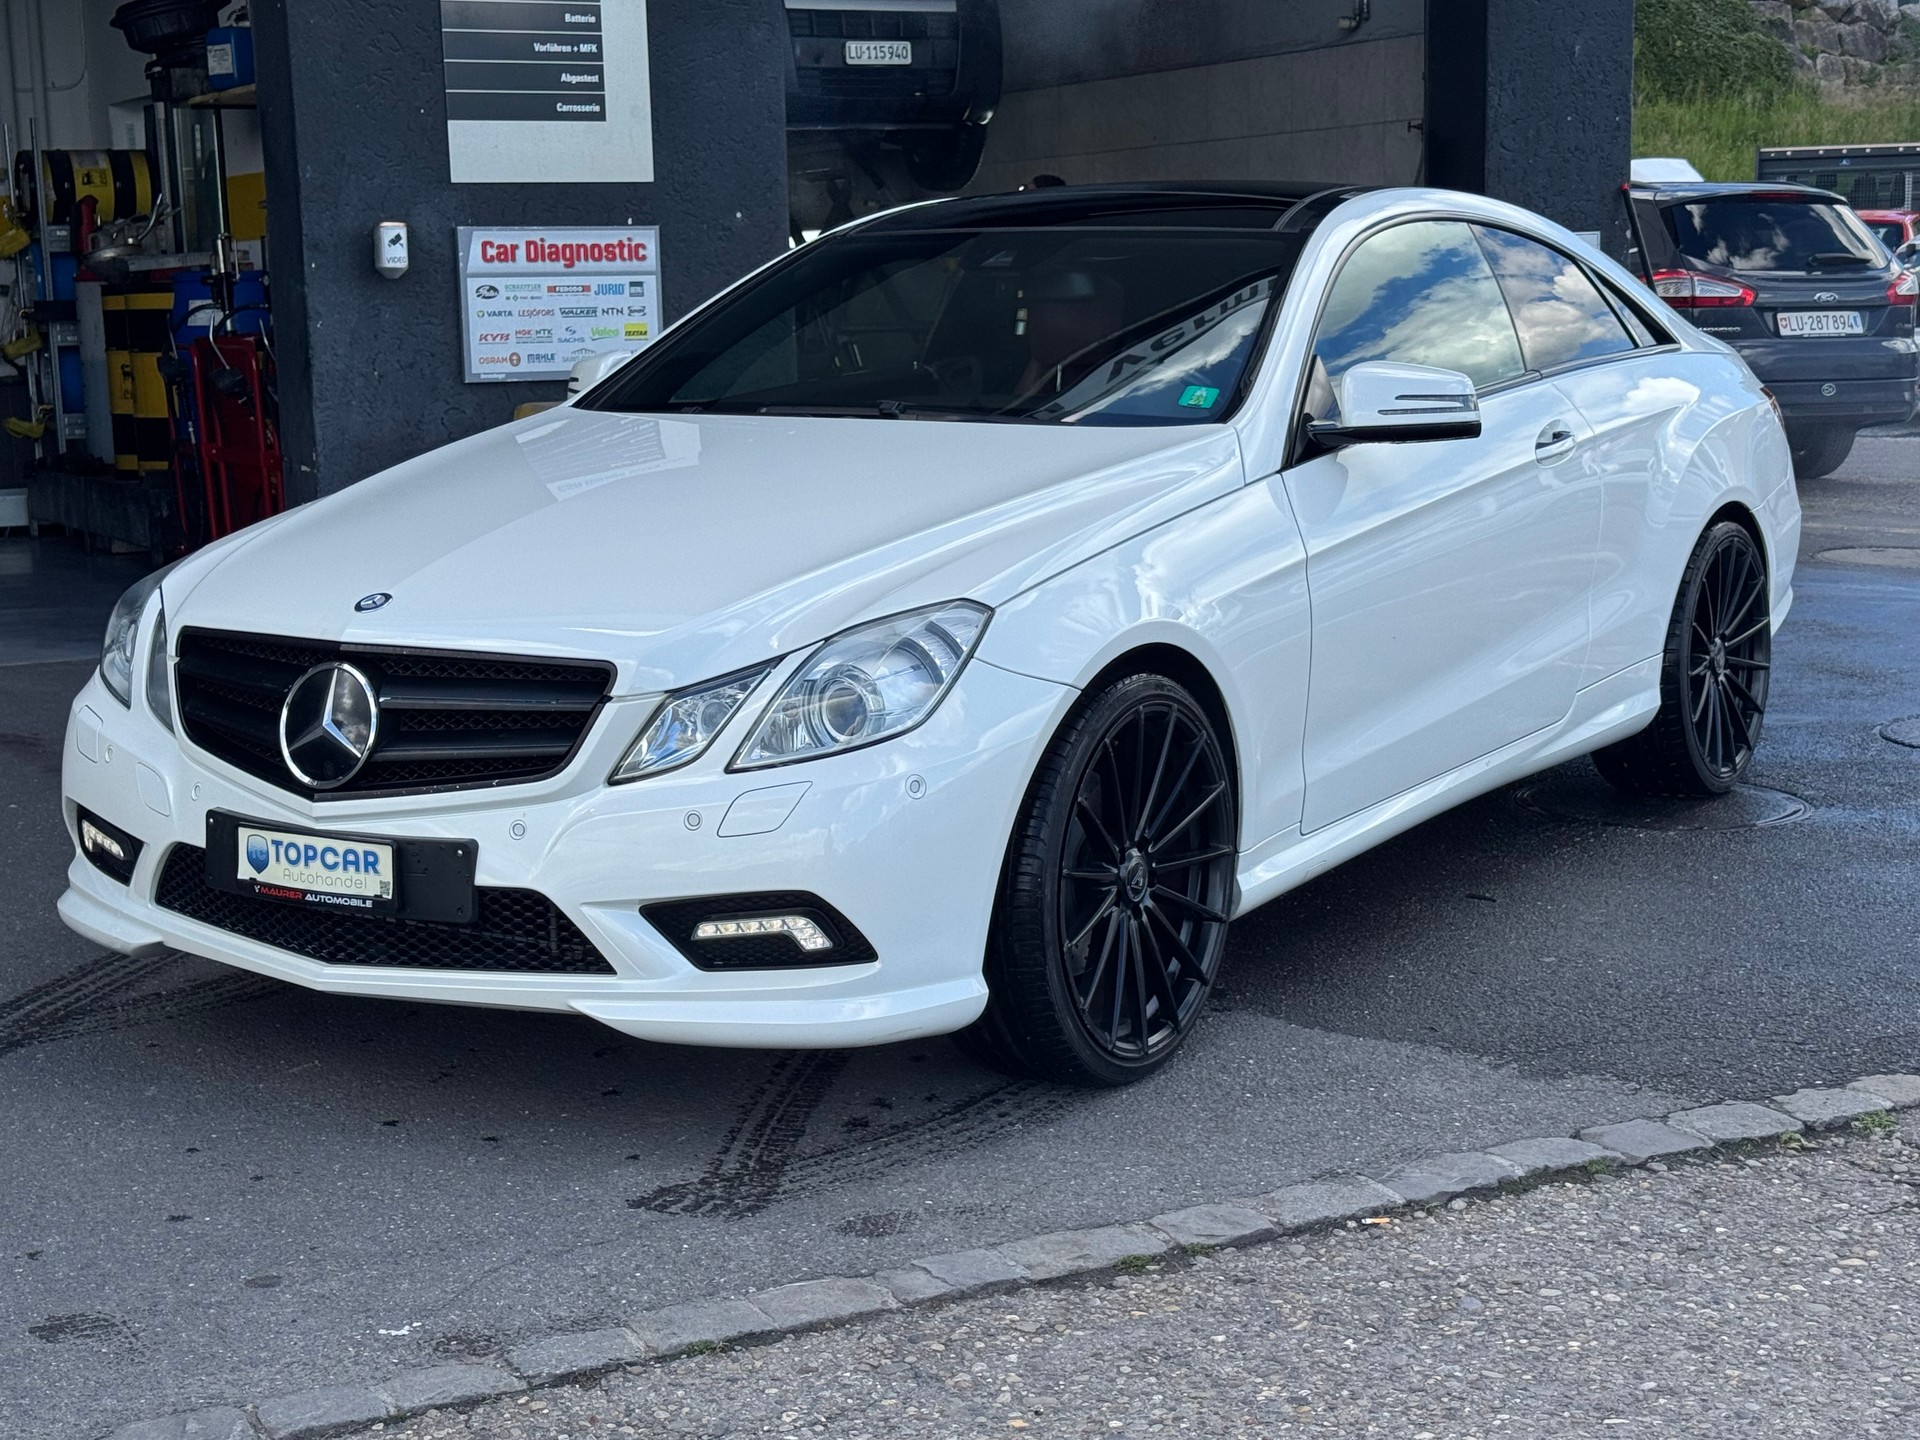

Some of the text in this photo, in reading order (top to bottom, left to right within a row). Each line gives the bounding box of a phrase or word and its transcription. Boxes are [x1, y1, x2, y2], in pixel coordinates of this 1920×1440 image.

[564, 13, 597, 24] Batterie
[533, 42, 572, 53] Vorführen
[579, 43, 598, 53] MFK
[560, 73, 599, 84] Abgastest
[556, 102, 600, 113] Carrosserie
[481, 237, 648, 268] Car Diagnostic
[386, 256, 407, 264] VIDEO
[594, 283, 625, 296] JURID
[601, 308, 624, 316] NTN
[478, 333, 511, 342] KYB
[478, 356, 508, 365] OSRAM
[527, 352, 556, 363] MAHLE
[271, 839, 380, 875] TOPCAR
[283, 868, 367, 889] Autohandel
[260, 886, 373, 908] MAURER AUTOMOBILE
